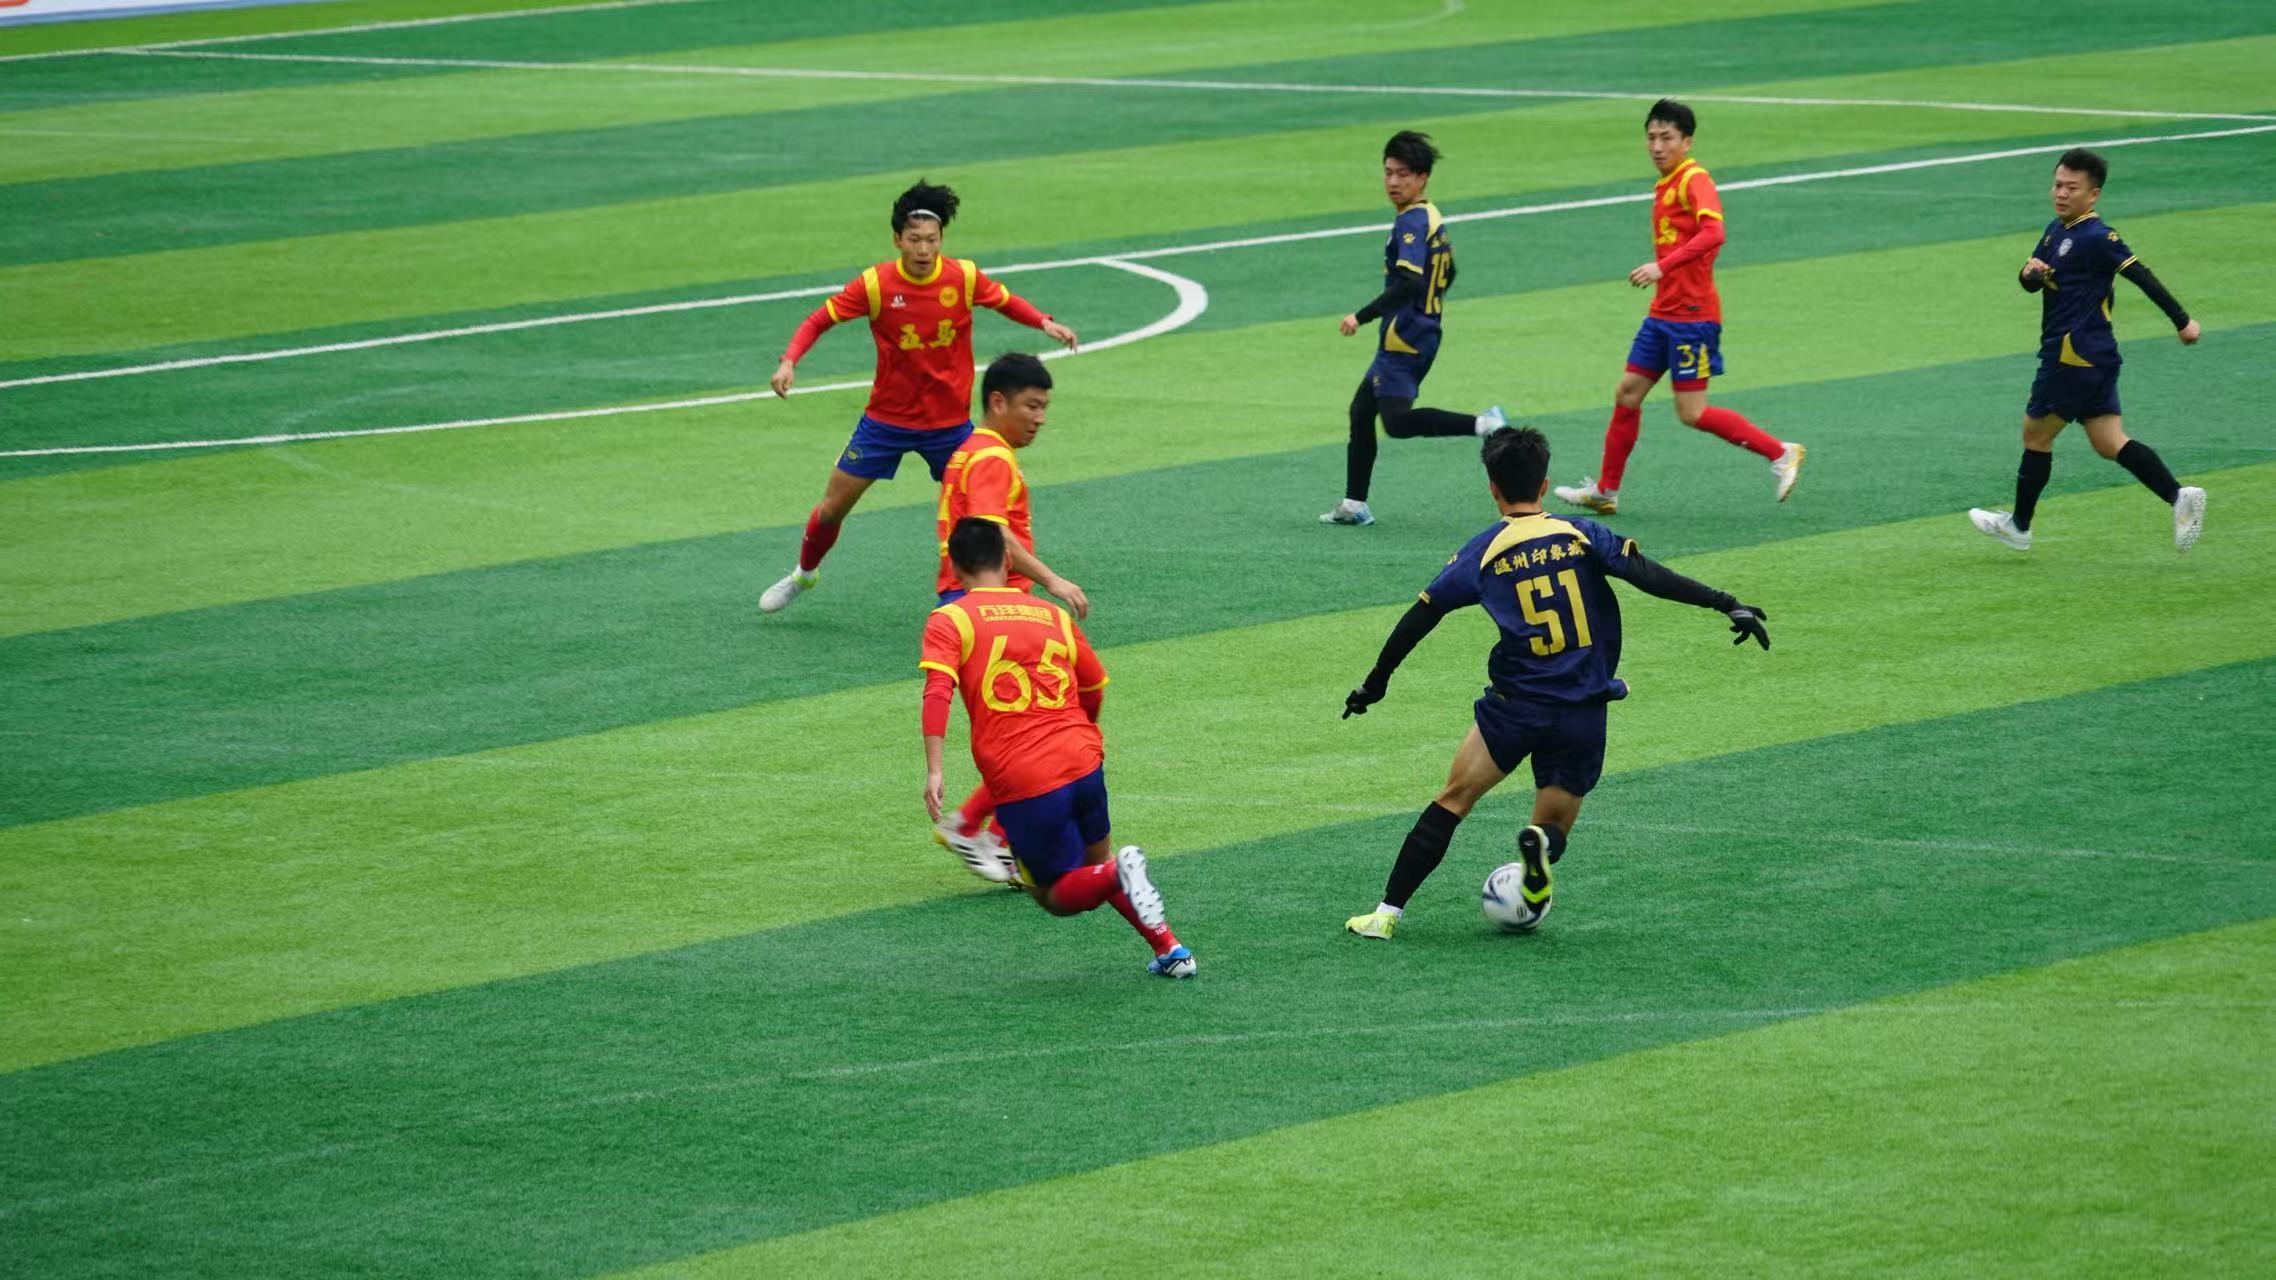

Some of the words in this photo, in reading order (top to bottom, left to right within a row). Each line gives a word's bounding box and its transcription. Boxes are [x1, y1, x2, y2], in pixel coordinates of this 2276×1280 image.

[1676, 345, 1695, 368] 3
[1494, 539, 1586, 575] 温州印象城
[1516, 568, 1593, 656] 51
[982, 635, 1070, 713] 65
